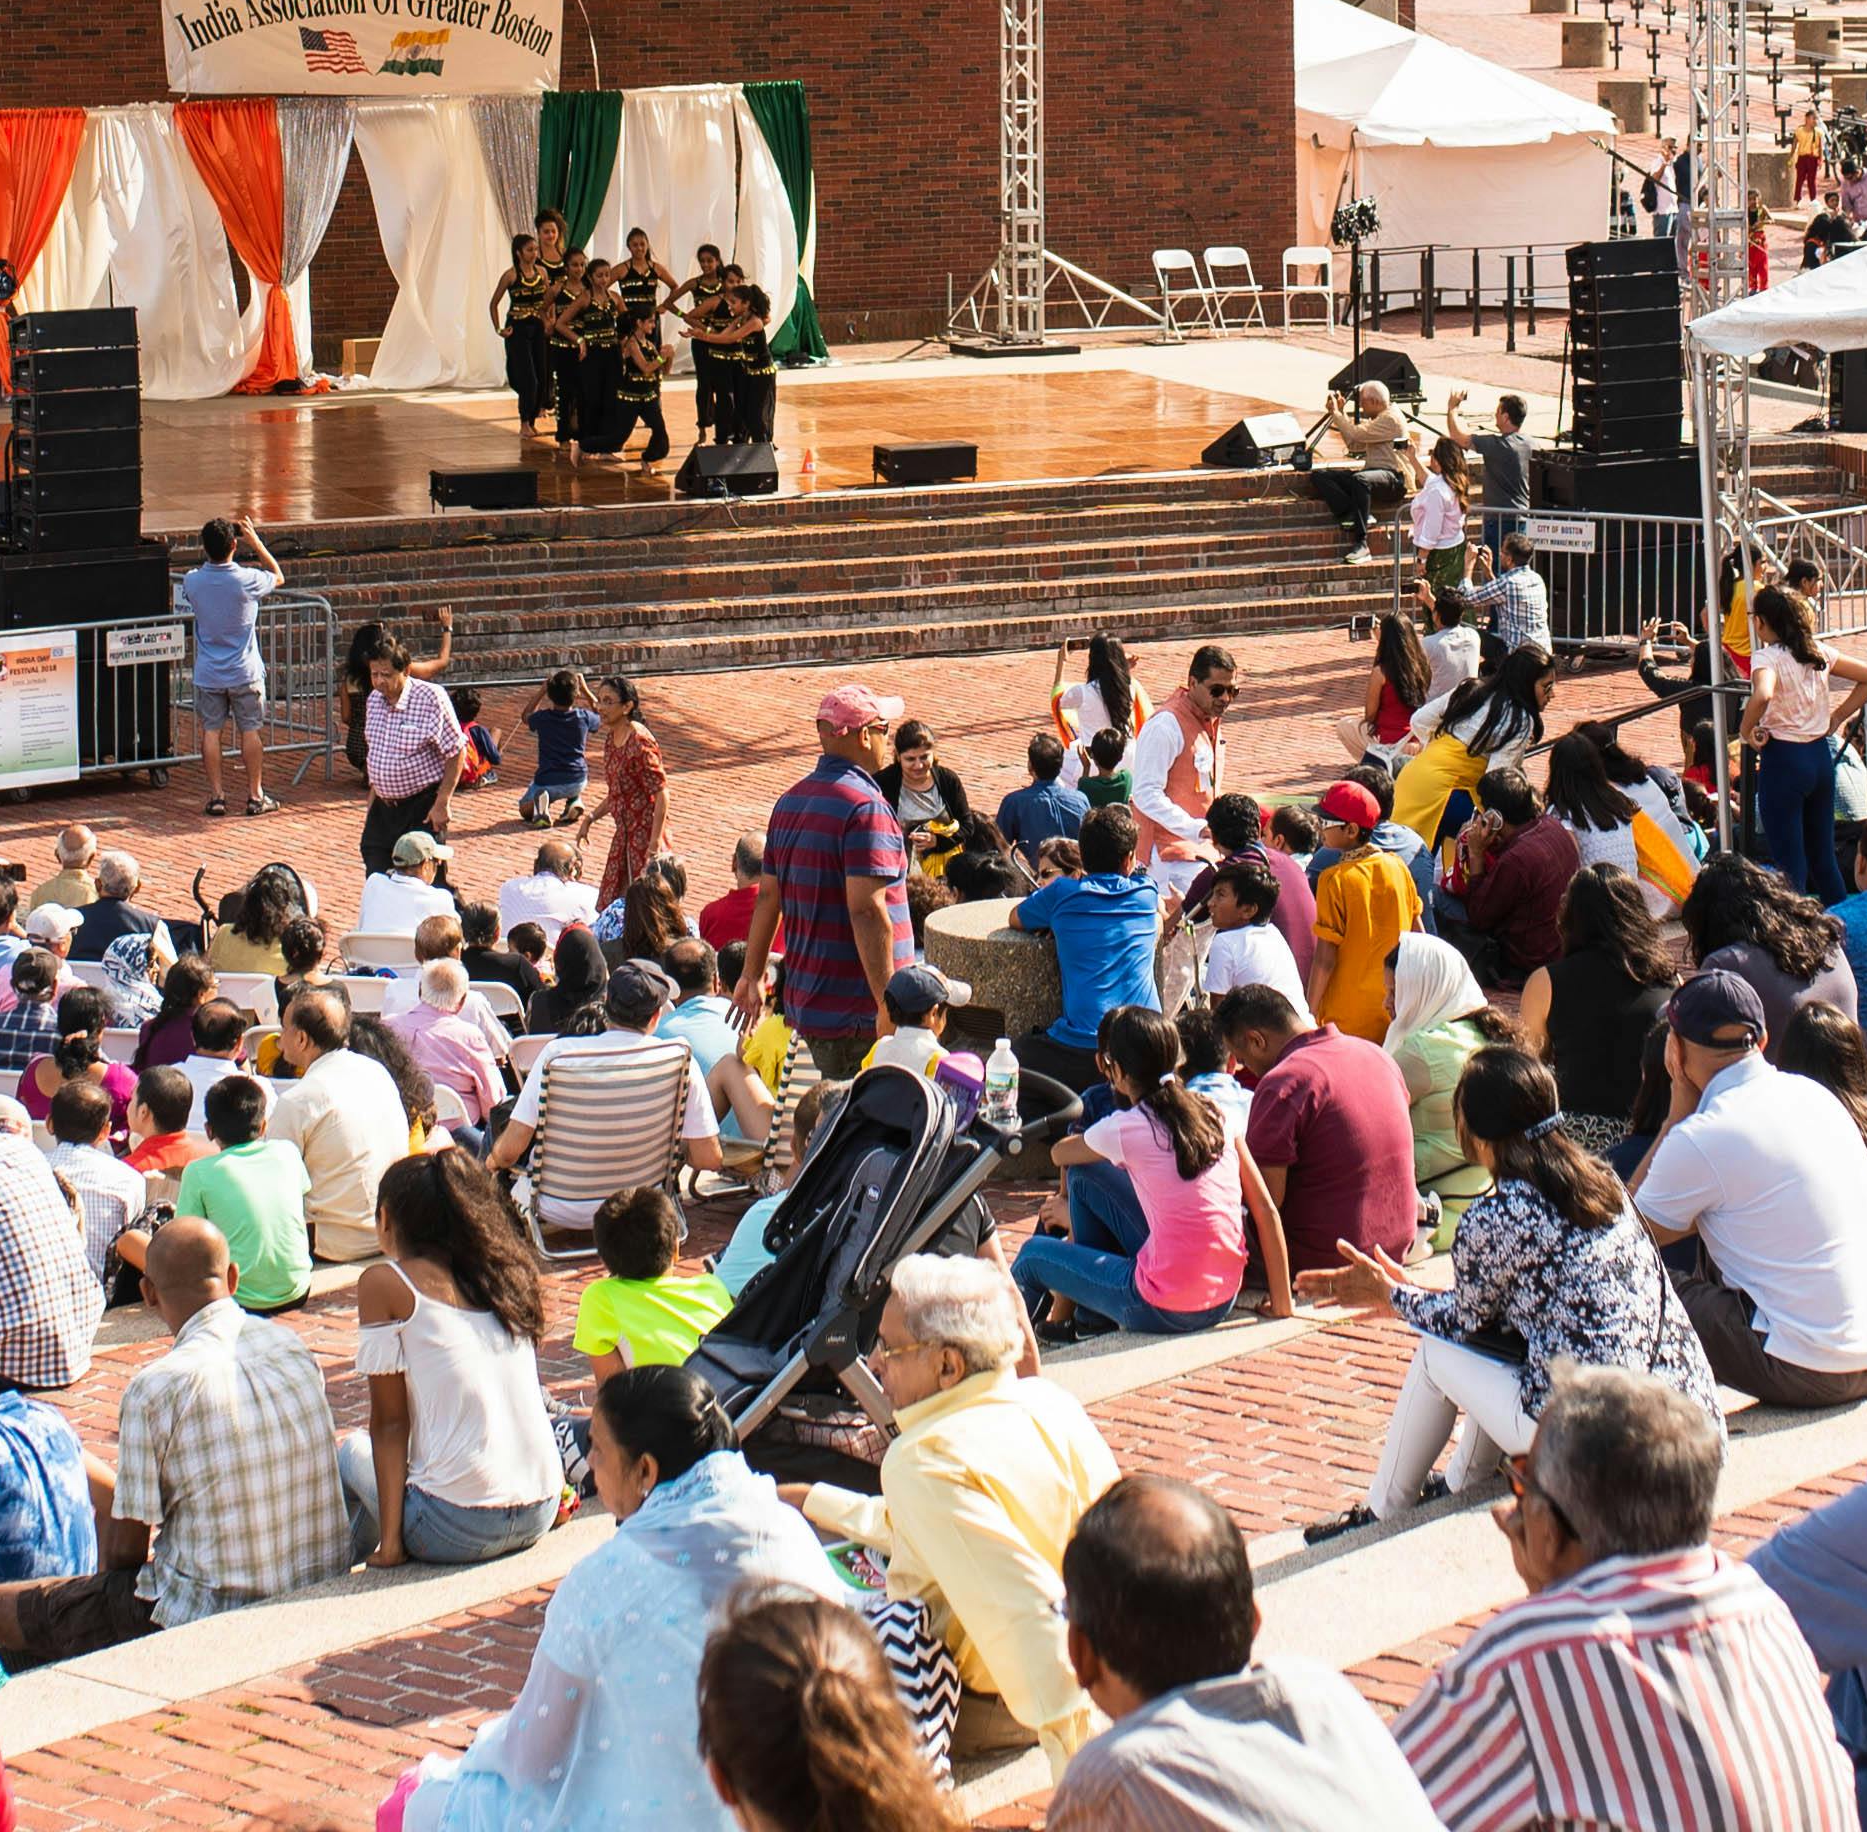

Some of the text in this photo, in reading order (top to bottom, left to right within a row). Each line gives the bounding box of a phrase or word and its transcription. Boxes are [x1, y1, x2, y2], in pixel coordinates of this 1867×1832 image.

[1561, 527, 1583, 535] BOSTON
[110, 651, 134, 659] PROPERTY
[136, 648, 169, 657] MANAGEMENT
[16, 656, 36, 664] INDIA
[10, 666, 39, 675] FESTIVAL
